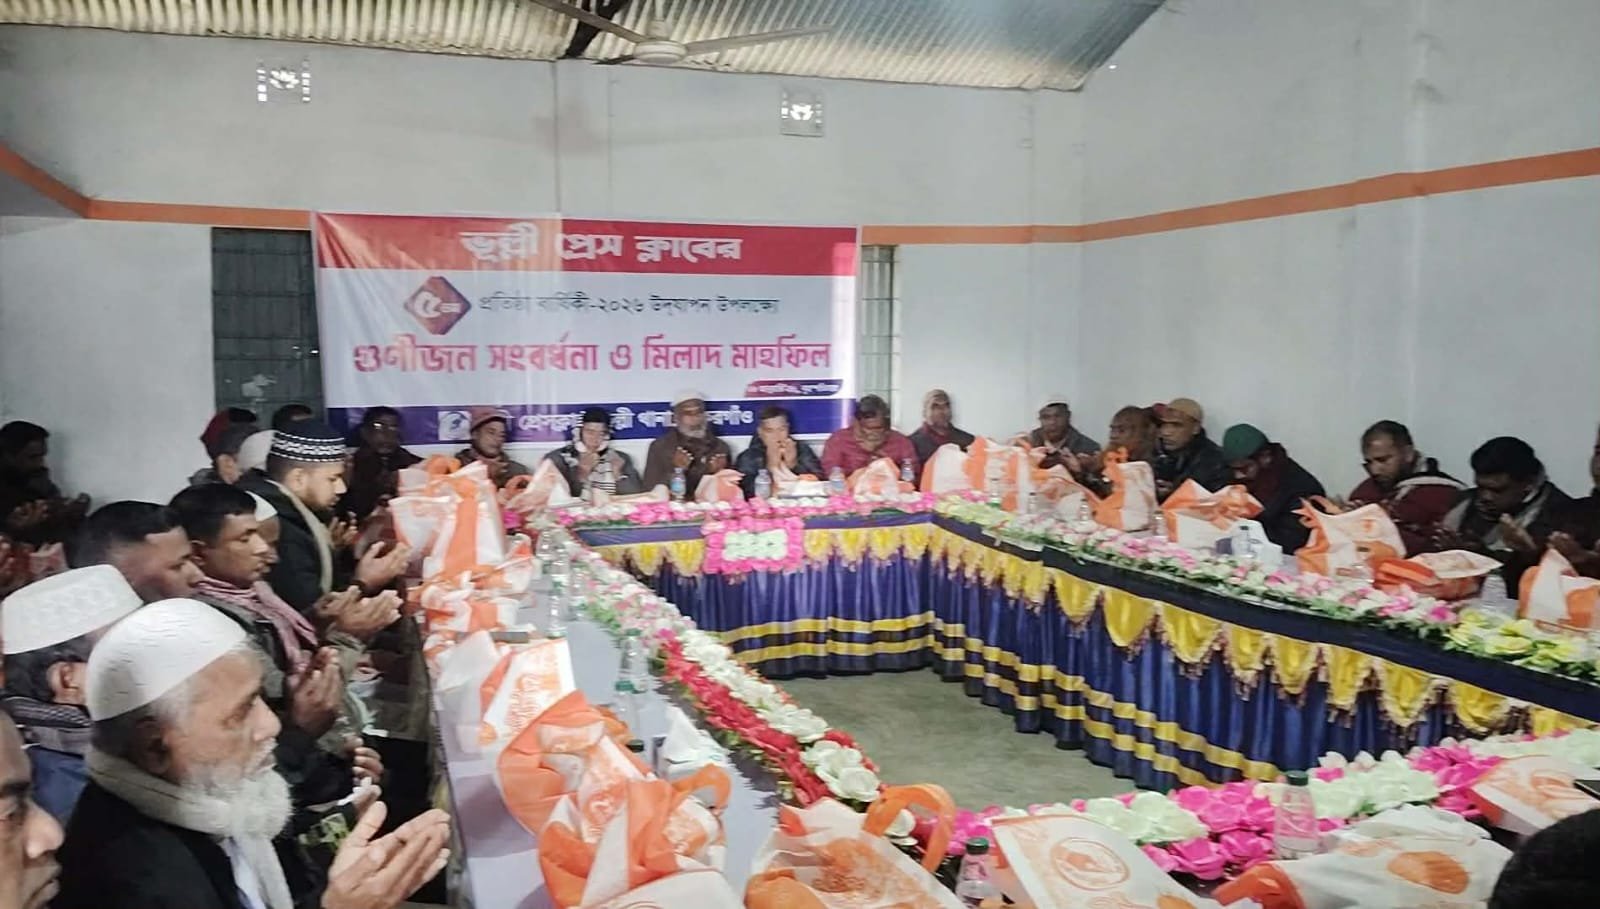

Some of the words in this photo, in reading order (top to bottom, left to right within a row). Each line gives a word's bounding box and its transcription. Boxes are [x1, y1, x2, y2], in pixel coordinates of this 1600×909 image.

[557, 233, 624, 261] প্রেস
[634, 235, 743, 262] ক্লাবের
[354, 333, 476, 372] গুণীজন
[486, 331, 598, 371] সংবর্ধনা
[609, 344, 633, 370] ও
[642, 334, 724, 370] মিলাদ
[730, 334, 832, 369] মাহফিল
